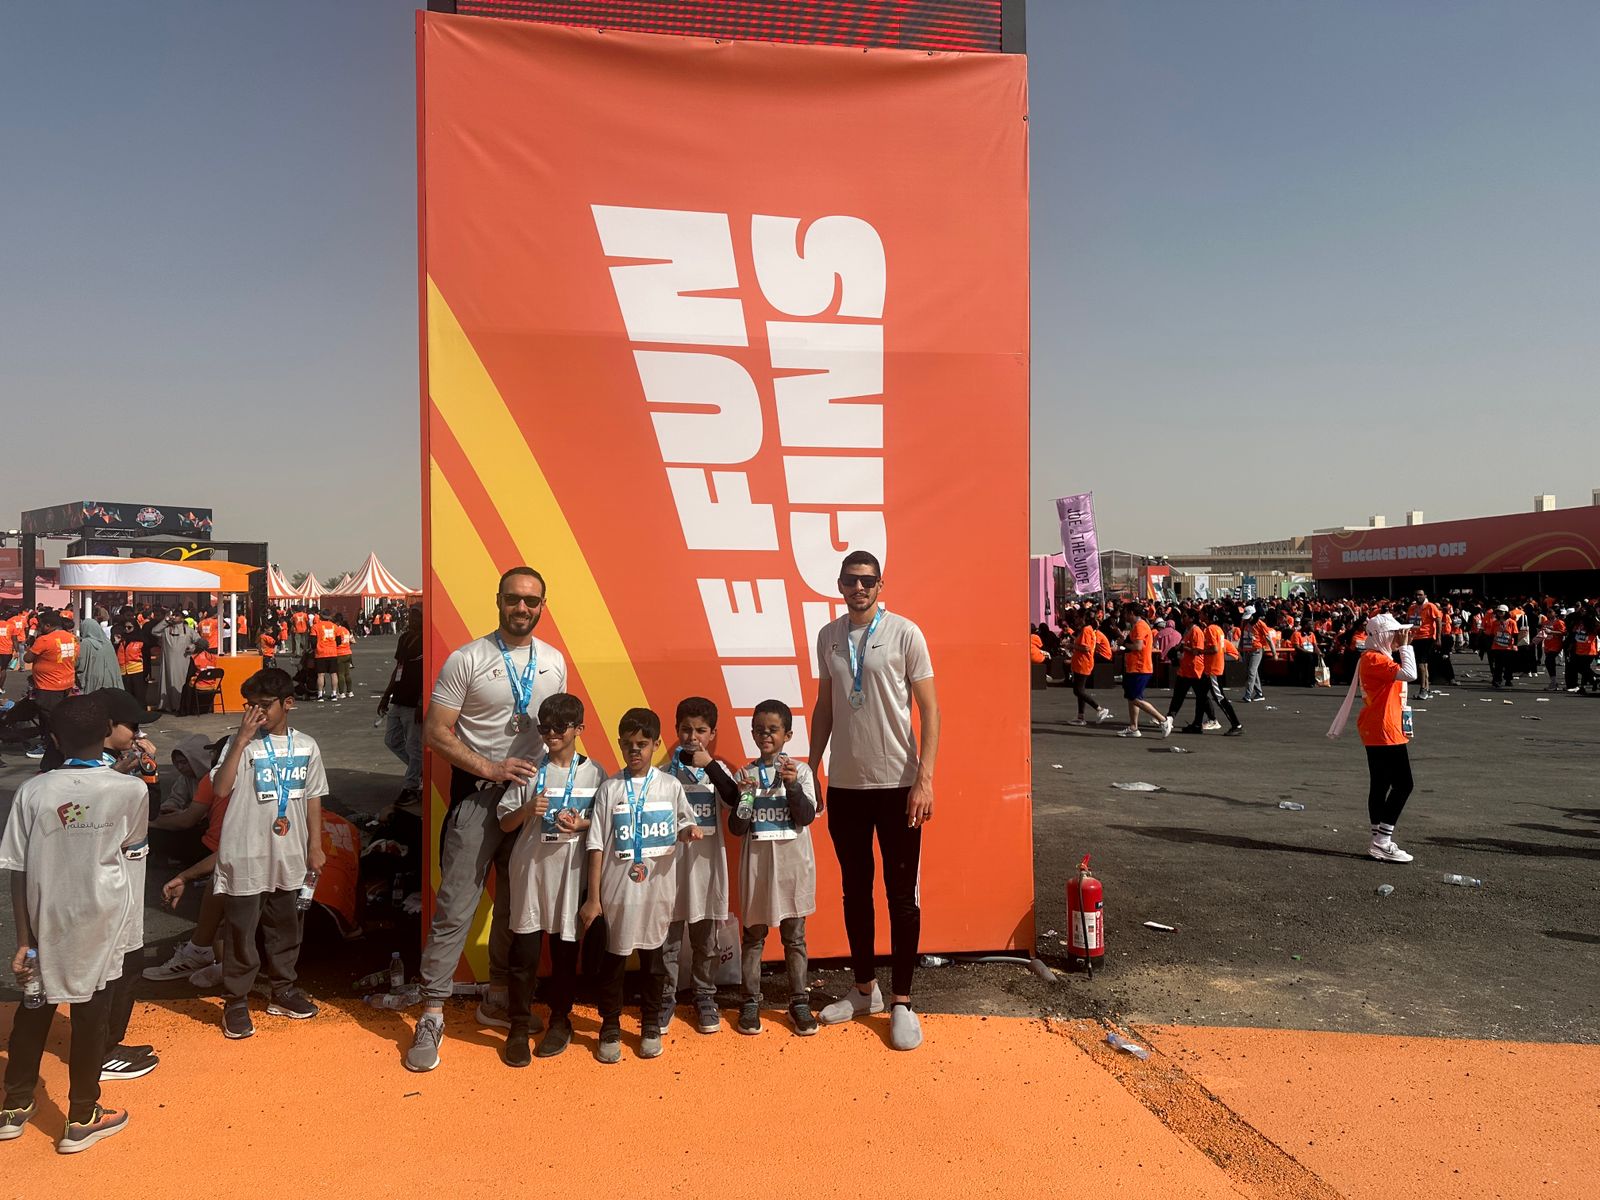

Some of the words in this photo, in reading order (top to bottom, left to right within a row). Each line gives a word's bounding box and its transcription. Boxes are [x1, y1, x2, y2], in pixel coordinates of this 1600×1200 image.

[590, 204, 780, 551] FUN
[751, 214, 887, 776] GINS
[1067, 508, 1082, 526] JOE
[1071, 534, 1086, 555] THE
[1342, 547, 1397, 563] BAGGAGE
[1398, 545, 1437, 560] DROP
[1439, 542, 1467, 557] OFF
[1073, 557, 1090, 584] JUICE
